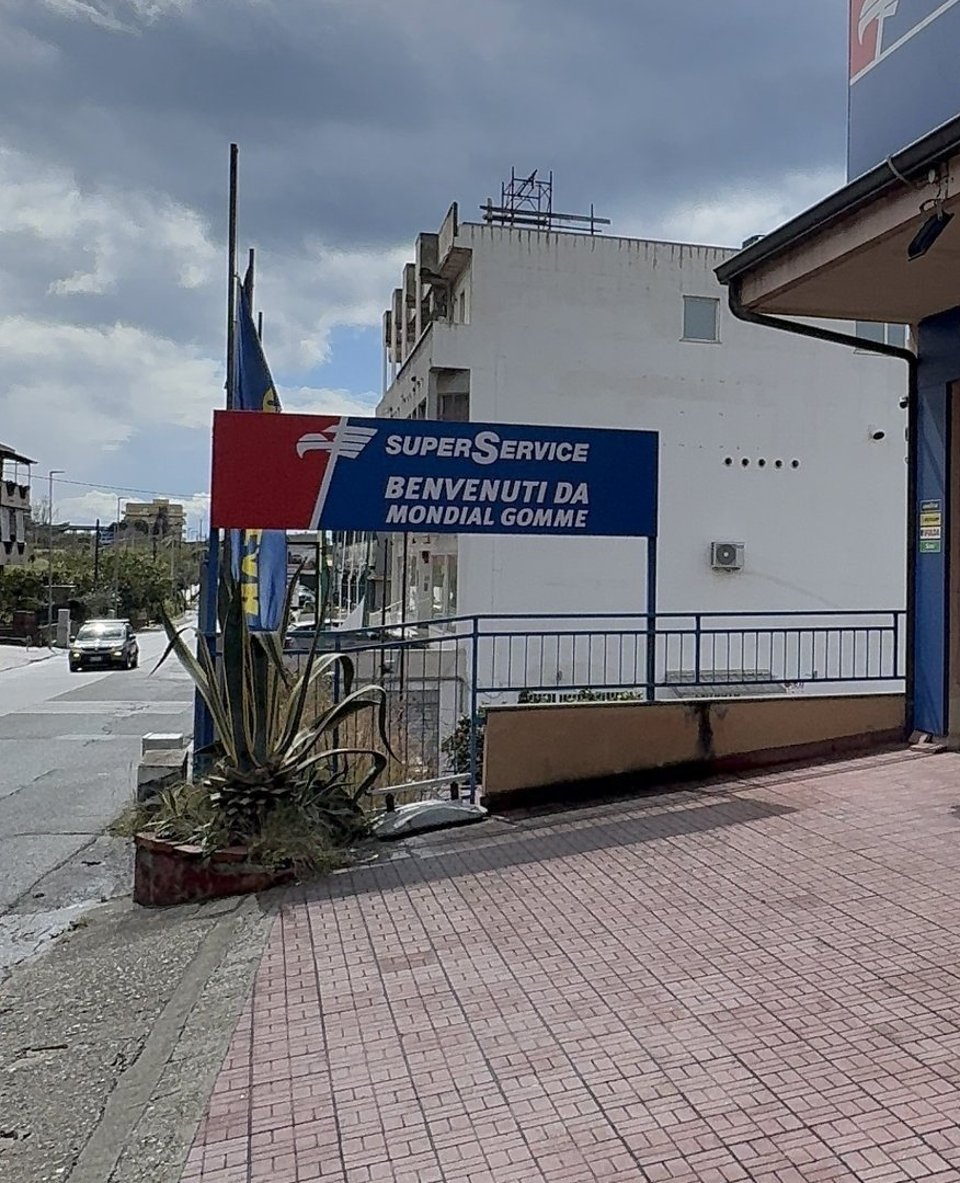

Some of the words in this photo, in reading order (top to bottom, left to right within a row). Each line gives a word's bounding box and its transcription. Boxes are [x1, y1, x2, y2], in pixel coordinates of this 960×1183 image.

[385, 476, 548, 504] BENVENUTI
[553, 482, 589, 505] DA
[385, 504, 495, 526] MONDIAL
[500, 508, 588, 528] GOMME
